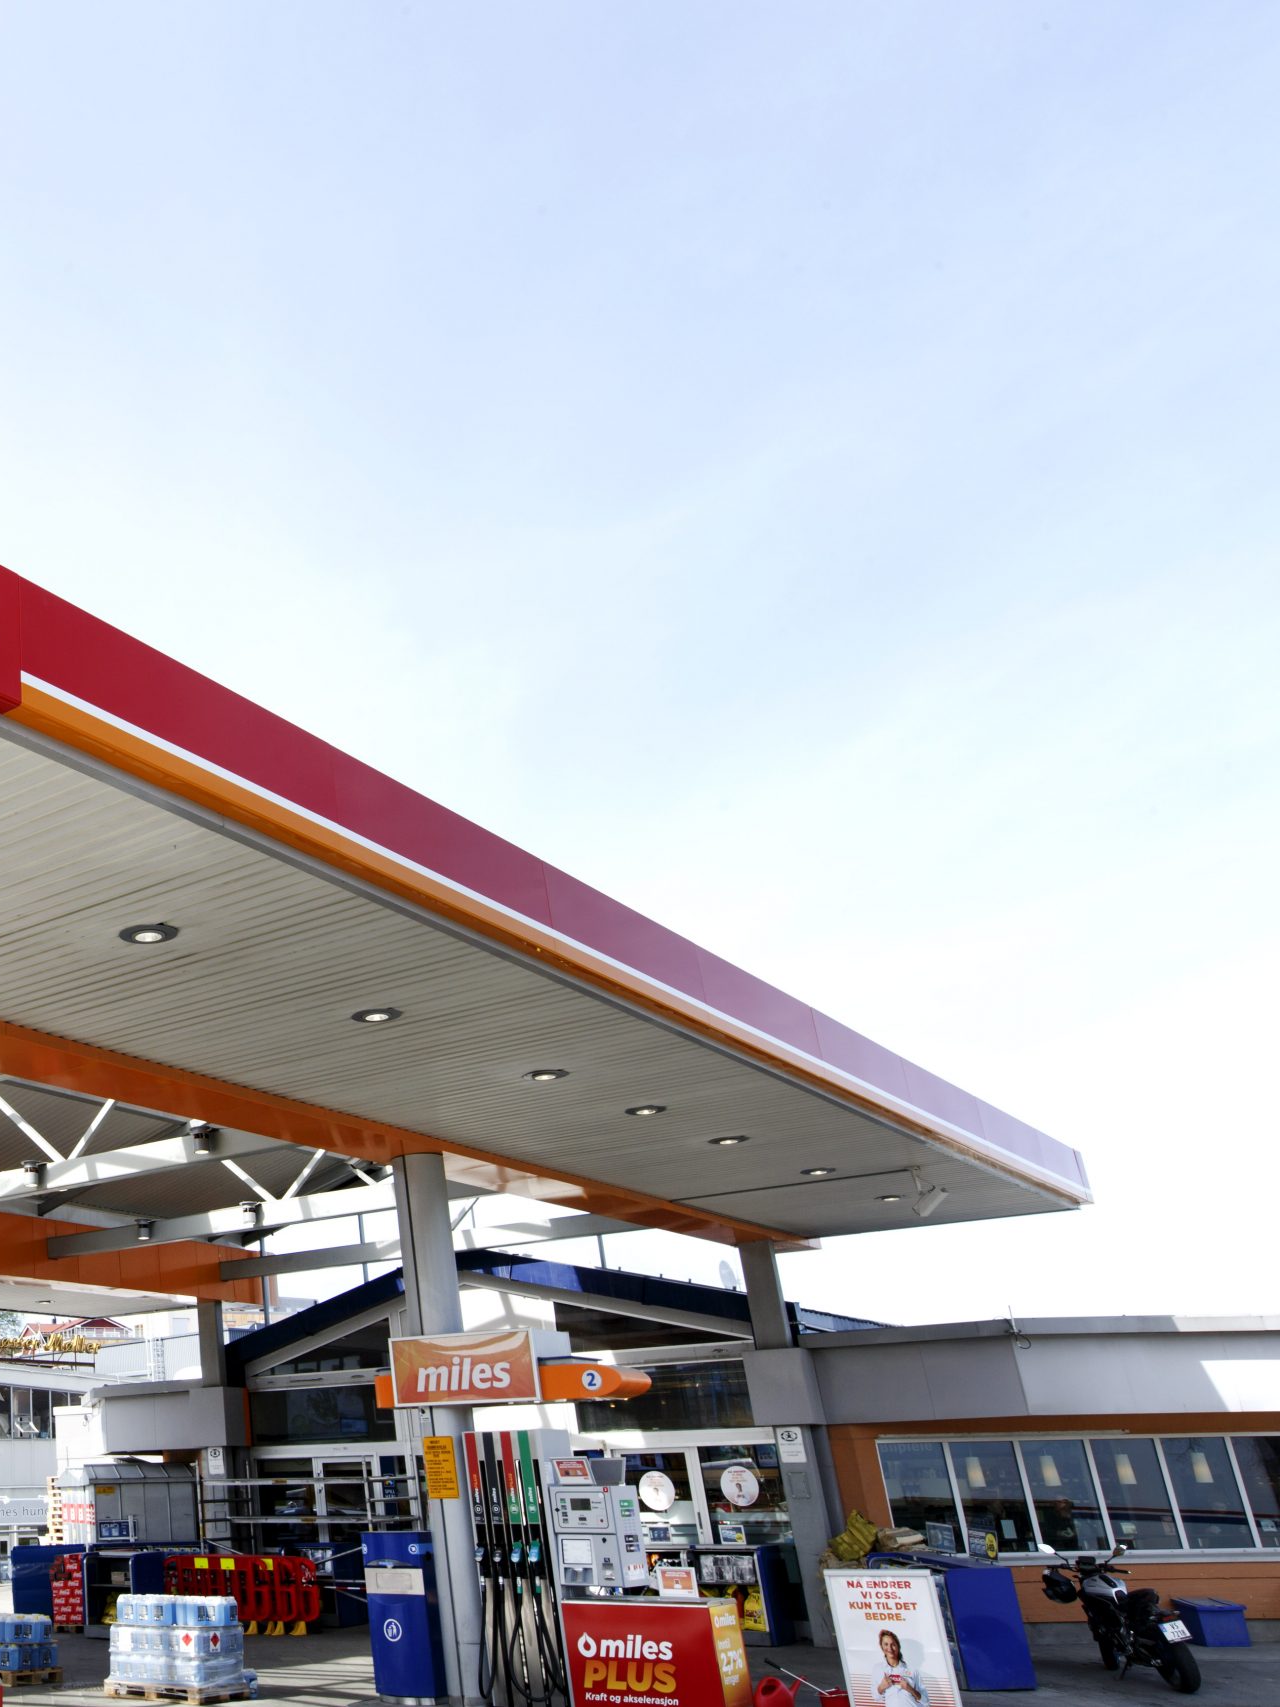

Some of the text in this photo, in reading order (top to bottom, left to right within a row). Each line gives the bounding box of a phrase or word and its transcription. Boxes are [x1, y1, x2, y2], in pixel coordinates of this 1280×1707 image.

[43, 1333, 102, 1354] Møller
[417, 1356, 511, 1393] miles
[586, 1372, 597, 1387] 2
[866, 1580, 912, 1589] ENDRER
[860, 1591, 901, 1600] VI OSS.
[849, 1601, 917, 1611] KUN TIL DET
[720, 1613, 736, 1626] miles
[864, 1612, 906, 1621] BEDRE.
[600, 1634, 673, 1660] miles
[583, 1660, 677, 1694] PLUS
[585, 1692, 679, 1706] Kraft og akselerasjon
